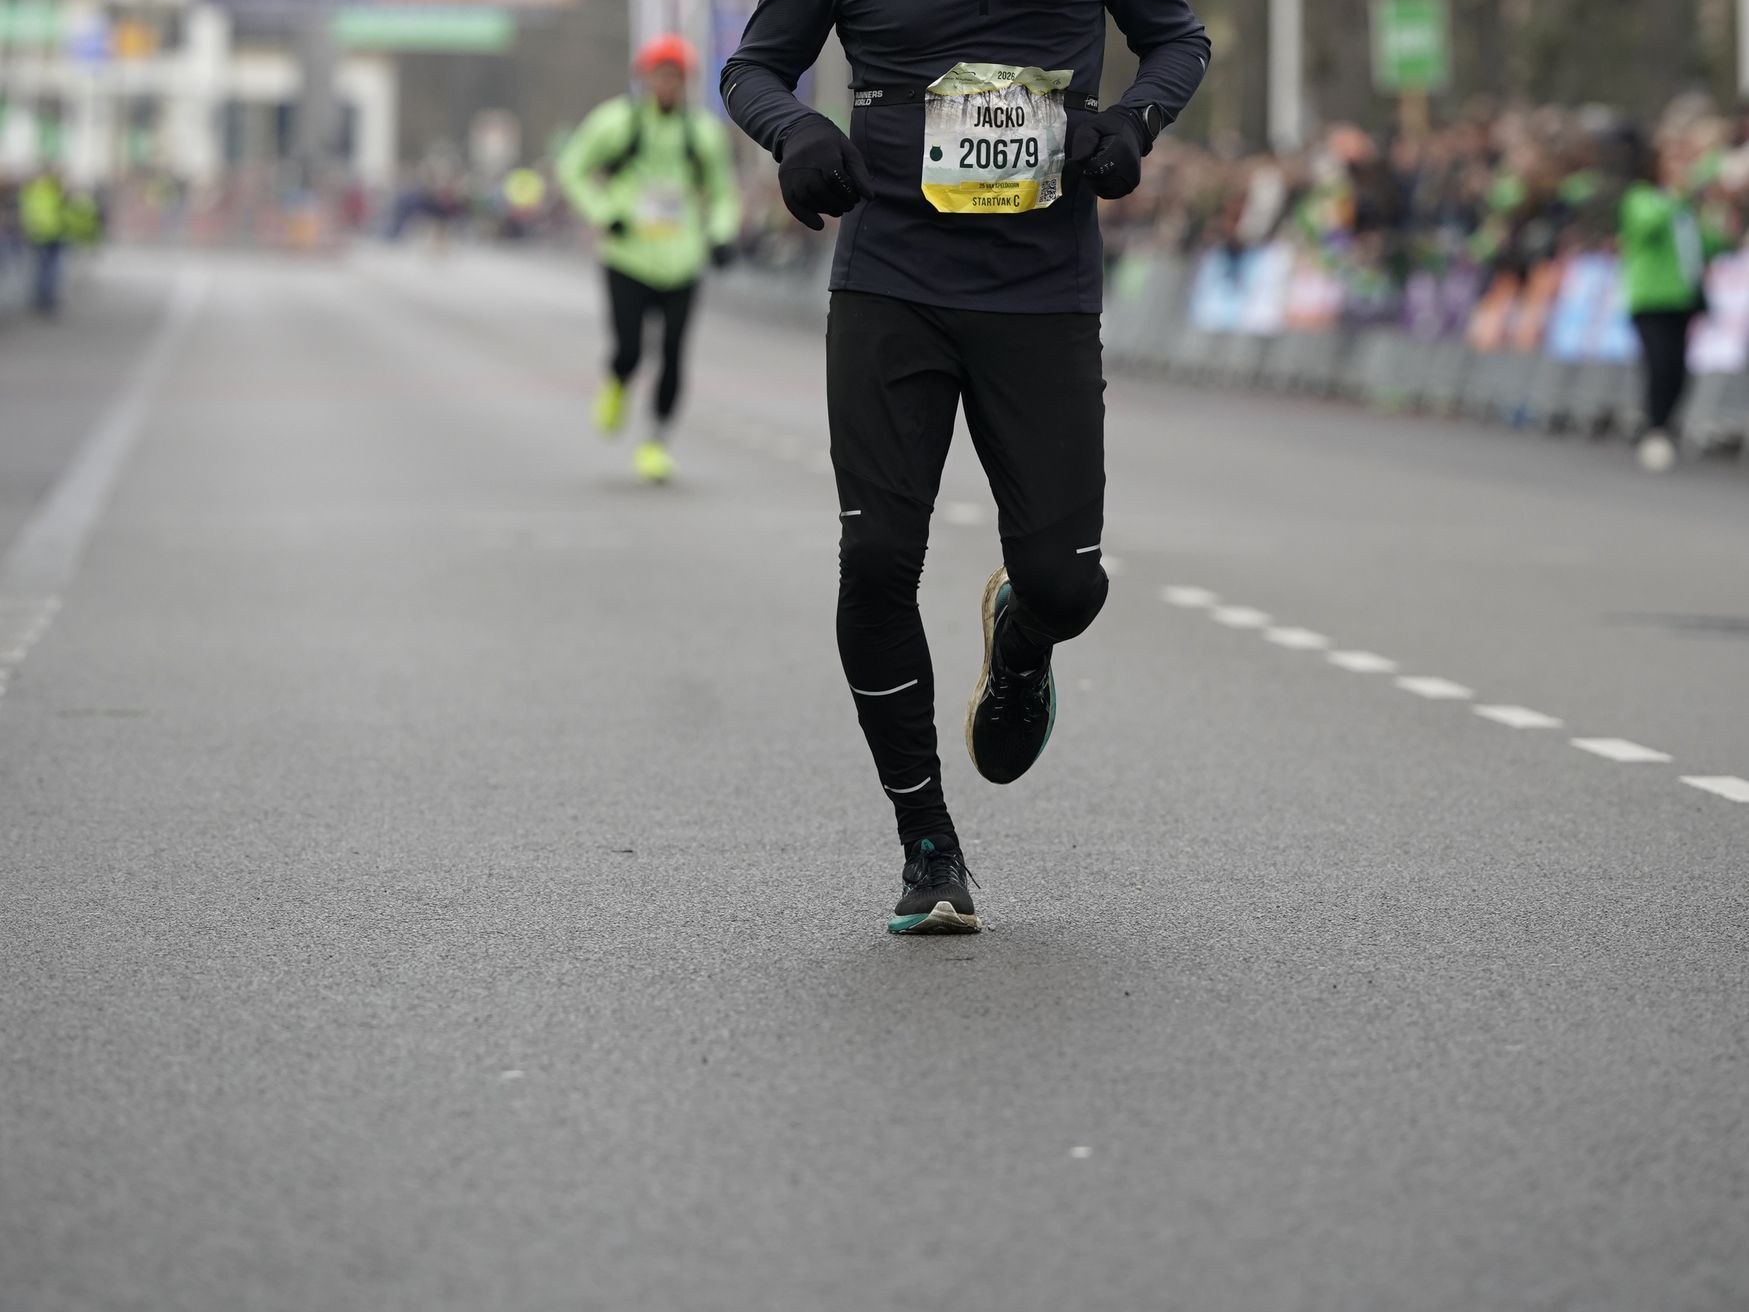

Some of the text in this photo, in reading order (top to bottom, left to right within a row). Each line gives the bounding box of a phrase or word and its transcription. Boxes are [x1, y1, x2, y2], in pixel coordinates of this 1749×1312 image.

[974, 106, 1025, 128] JACKO
[959, 137, 1039, 169] 20679
[972, 194, 1020, 208] STARTVAK C
